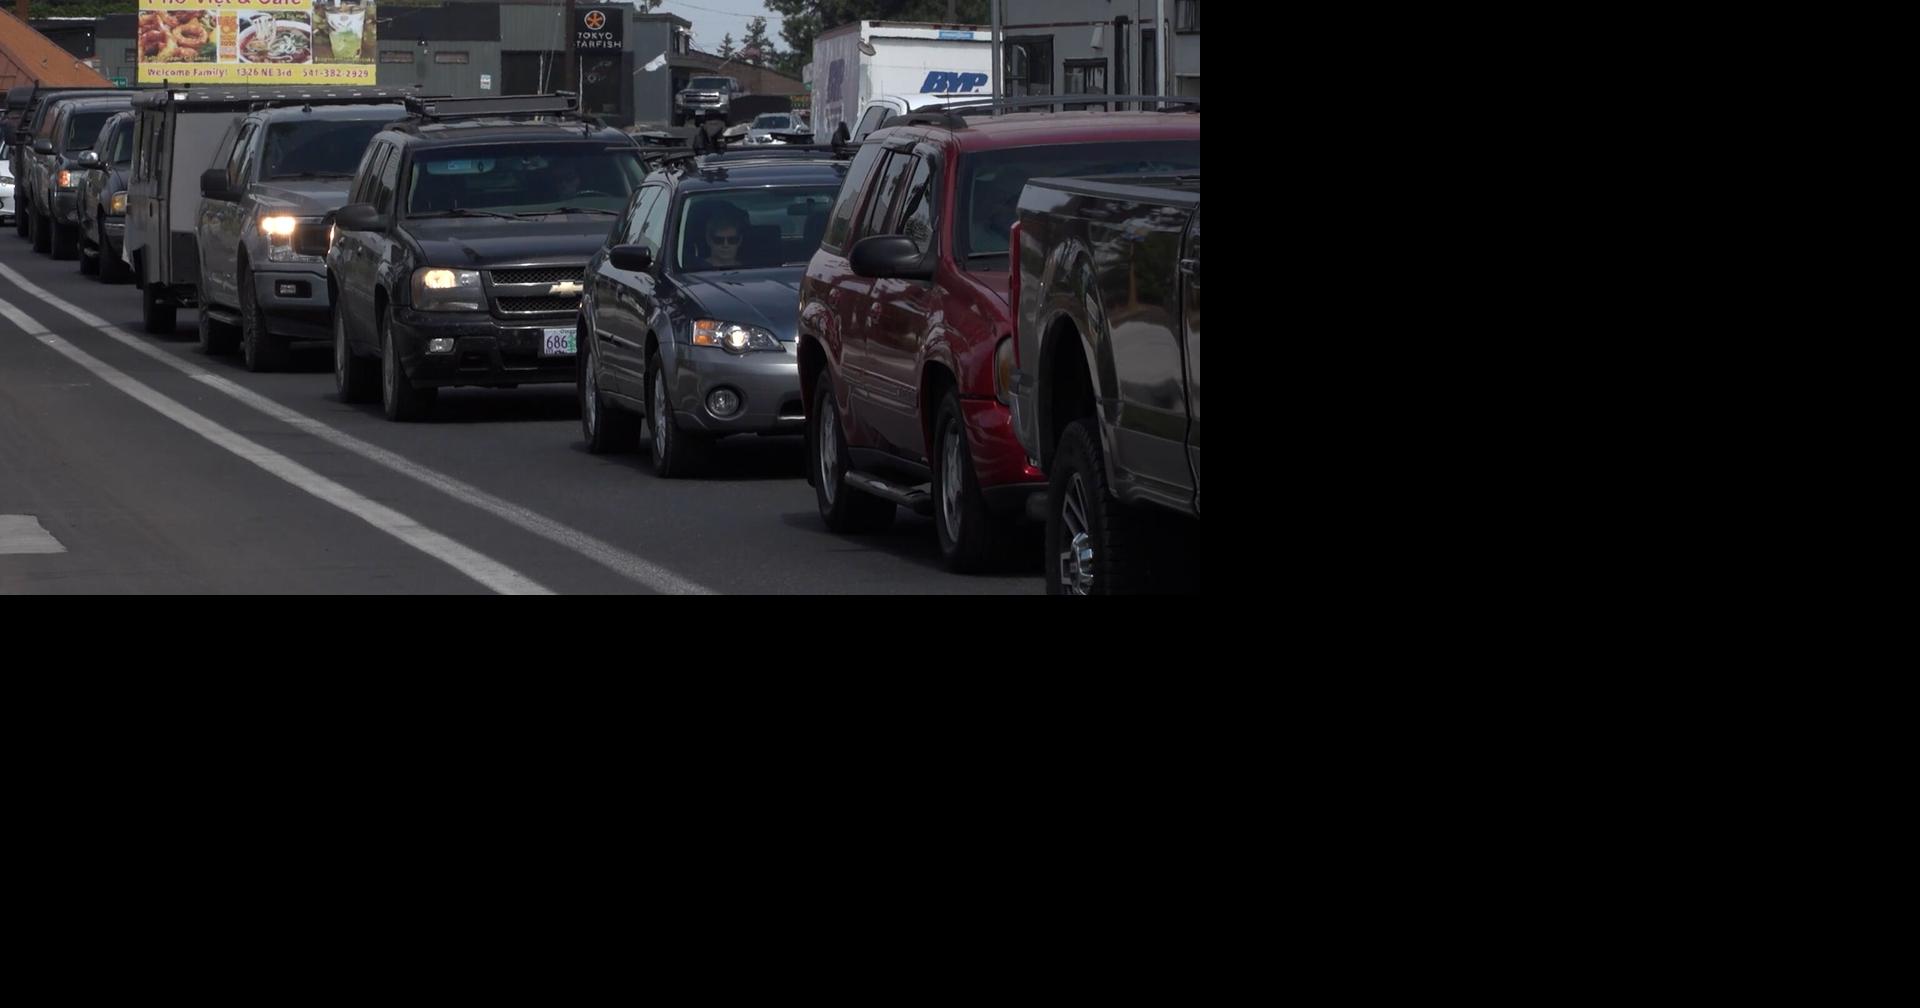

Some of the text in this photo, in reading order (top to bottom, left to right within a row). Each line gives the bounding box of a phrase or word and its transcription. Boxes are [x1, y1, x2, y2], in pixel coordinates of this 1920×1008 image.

[578, 32, 613, 40] TOKYO
[147, 68, 190, 76] Welcome
[277, 69, 292, 77] 3rd
